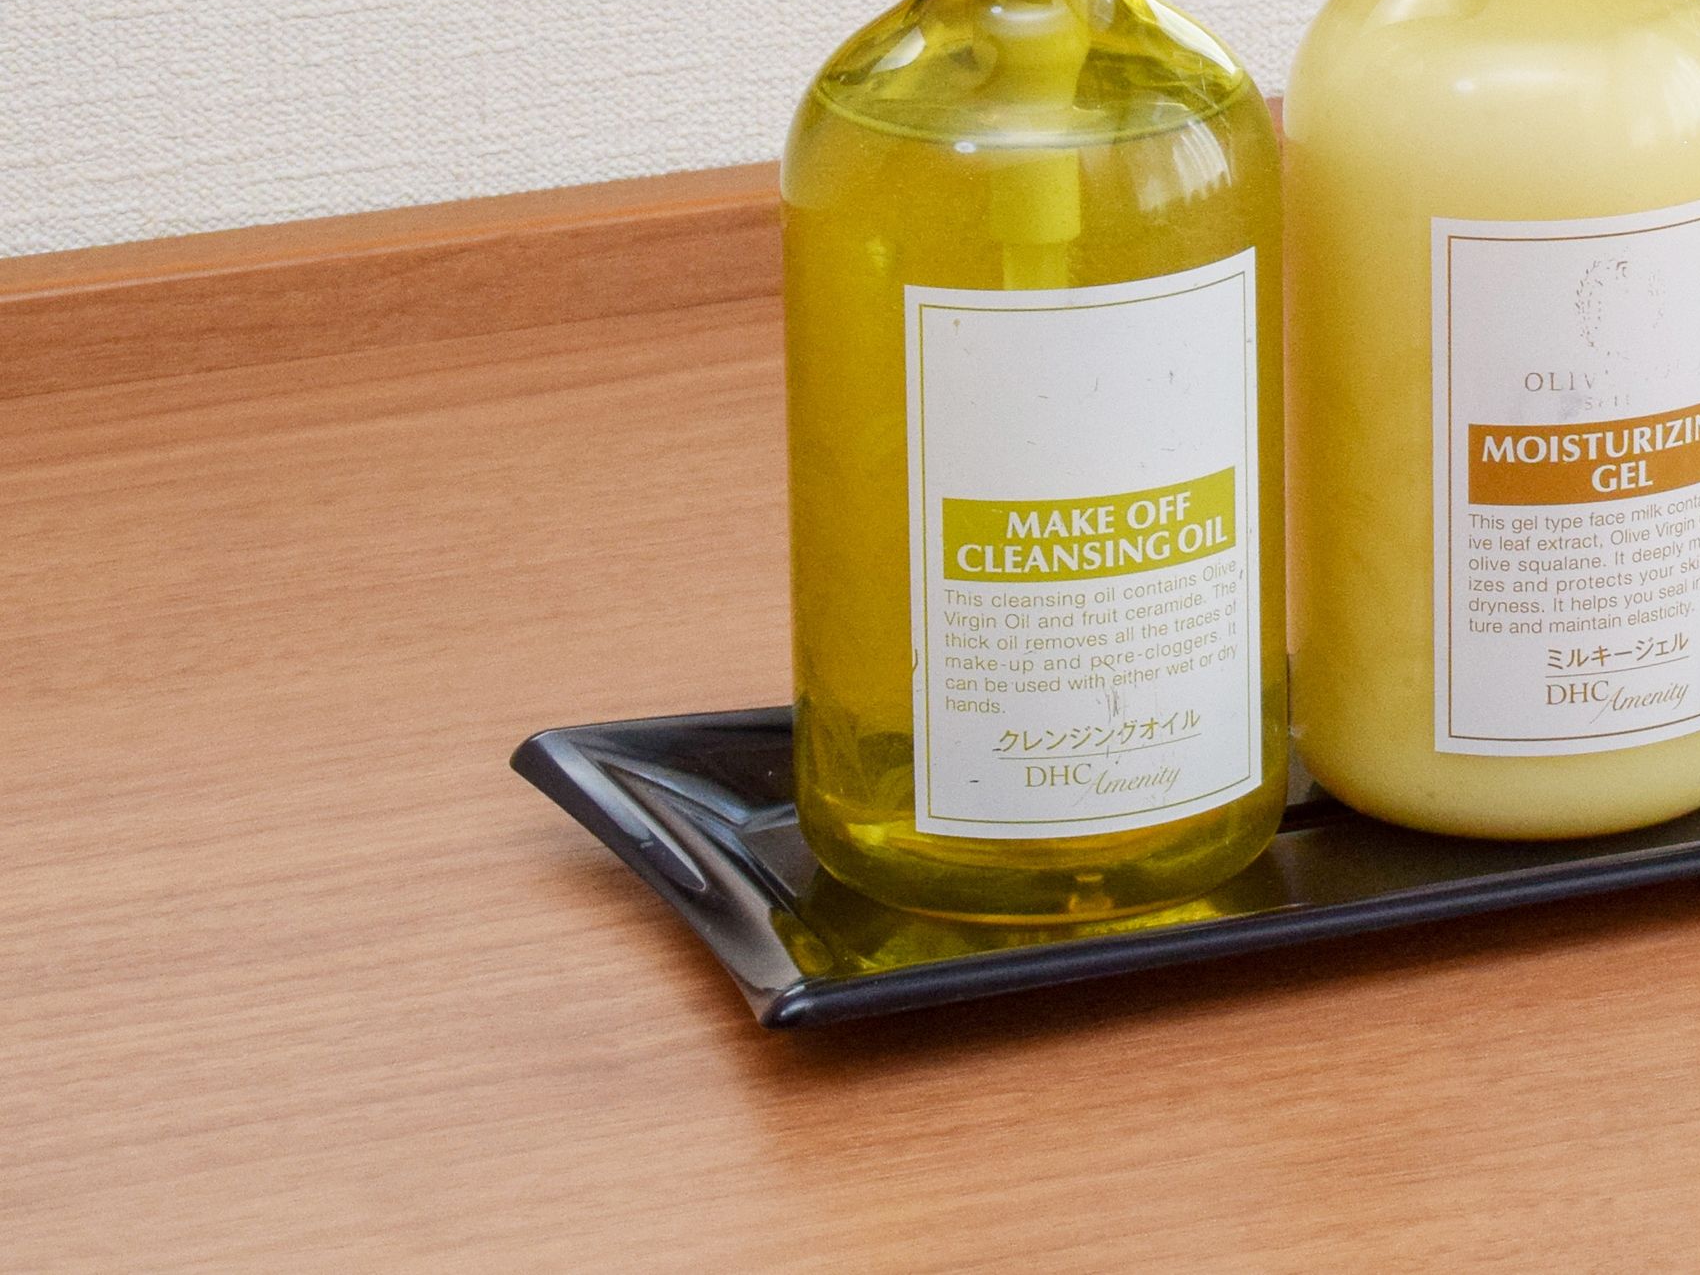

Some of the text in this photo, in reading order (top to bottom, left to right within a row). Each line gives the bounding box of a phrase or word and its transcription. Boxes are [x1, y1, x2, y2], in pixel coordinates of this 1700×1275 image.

[1592, 460, 1654, 492] GEL
[1006, 491, 1191, 539] MAKE OFF
[1468, 514, 1505, 530] This
[1512, 516, 1537, 533] gel
[1545, 515, 1582, 533] type
[1589, 511, 1625, 527] face
[1631, 504, 1662, 522] milk
[957, 516, 1227, 573] CLEANSING OIL
[1469, 536, 1492, 550] ive
[1500, 536, 1530, 551] leaf
[1610, 528, 1649, 546] Olive
[1655, 518, 1695, 539] Virgin
[1469, 556, 1510, 572] olive
[1518, 556, 1606, 574] squalane.
[1615, 551, 1624, 564] It
[1632, 541, 1682, 564] deeply
[944, 560, 1236, 612] This cleansing oil contains Olive
[1469, 578, 1504, 592] izes
[1513, 578, 1548, 593] and
[1556, 572, 1632, 595] protects
[1639, 565, 1674, 585] your
[1469, 599, 1545, 616] dryness.
[1554, 599, 1564, 612] It
[1571, 593, 1617, 615] helps
[1624, 588, 1652, 608] you
[1658, 581, 1687, 597] seal
[944, 612, 996, 631] Virgin
[1005, 613, 1029, 629] Oil
[1038, 613, 1073, 629] and
[1082, 609, 1118, 627] fruit
[1213, 581, 1236, 599] The
[1469, 600, 1695, 634] ture and maintain elasticity.
[945, 611, 1221, 651] thick oil removes all the traces
[945, 630, 1219, 674] make-up and pore-cloggers.
[945, 644, 1238, 692] can be used with either wet or dry
[1548, 632, 1689, 670] ミルキージェル
[945, 696, 1005, 714] hands.
[1545, 680, 1689, 724] DHC Amenity
[999, 709, 1200, 753] クレンジングオイル
[1025, 763, 1180, 795] DHC Amenity
